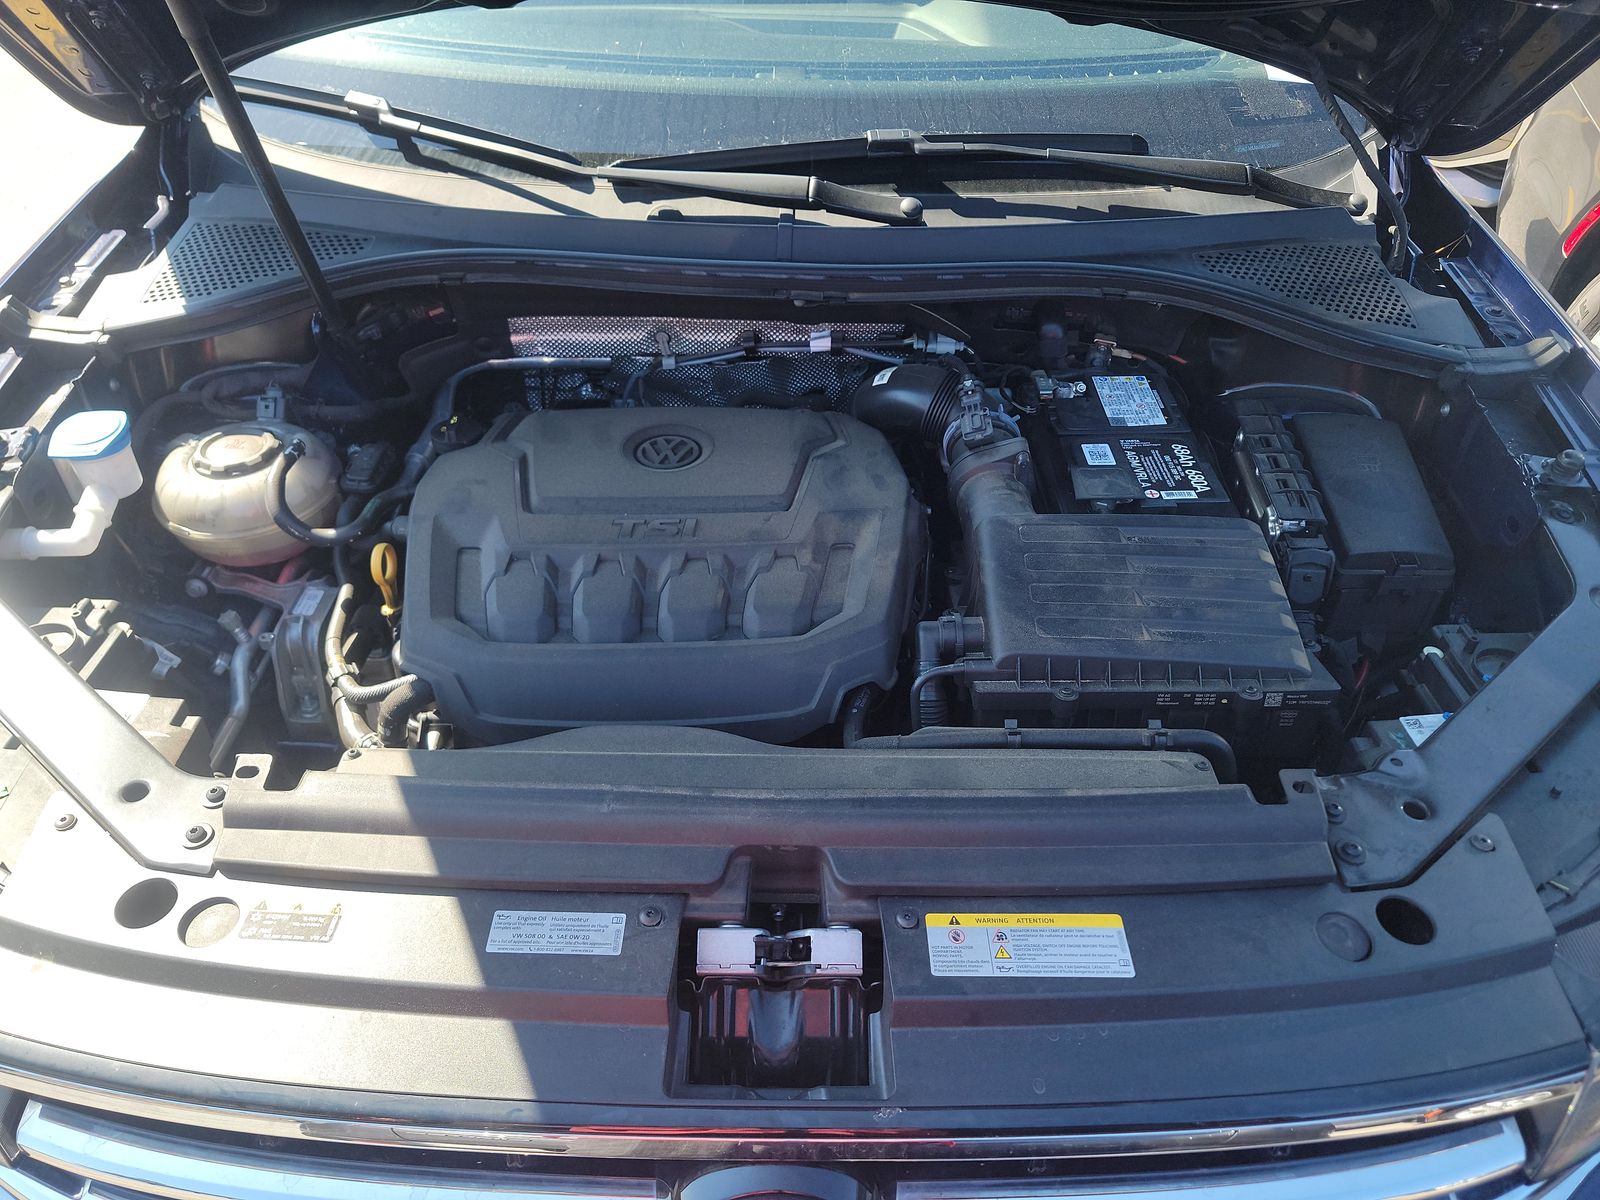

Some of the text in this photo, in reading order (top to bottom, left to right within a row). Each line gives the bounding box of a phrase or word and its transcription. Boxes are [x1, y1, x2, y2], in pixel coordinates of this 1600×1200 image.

[1124, 450, 1152, 488] AGM/VRLA
[1171, 444, 1196, 467] 68Ah
[1185, 469, 1211, 493] 680A
[610, 518, 698, 538] TSI
